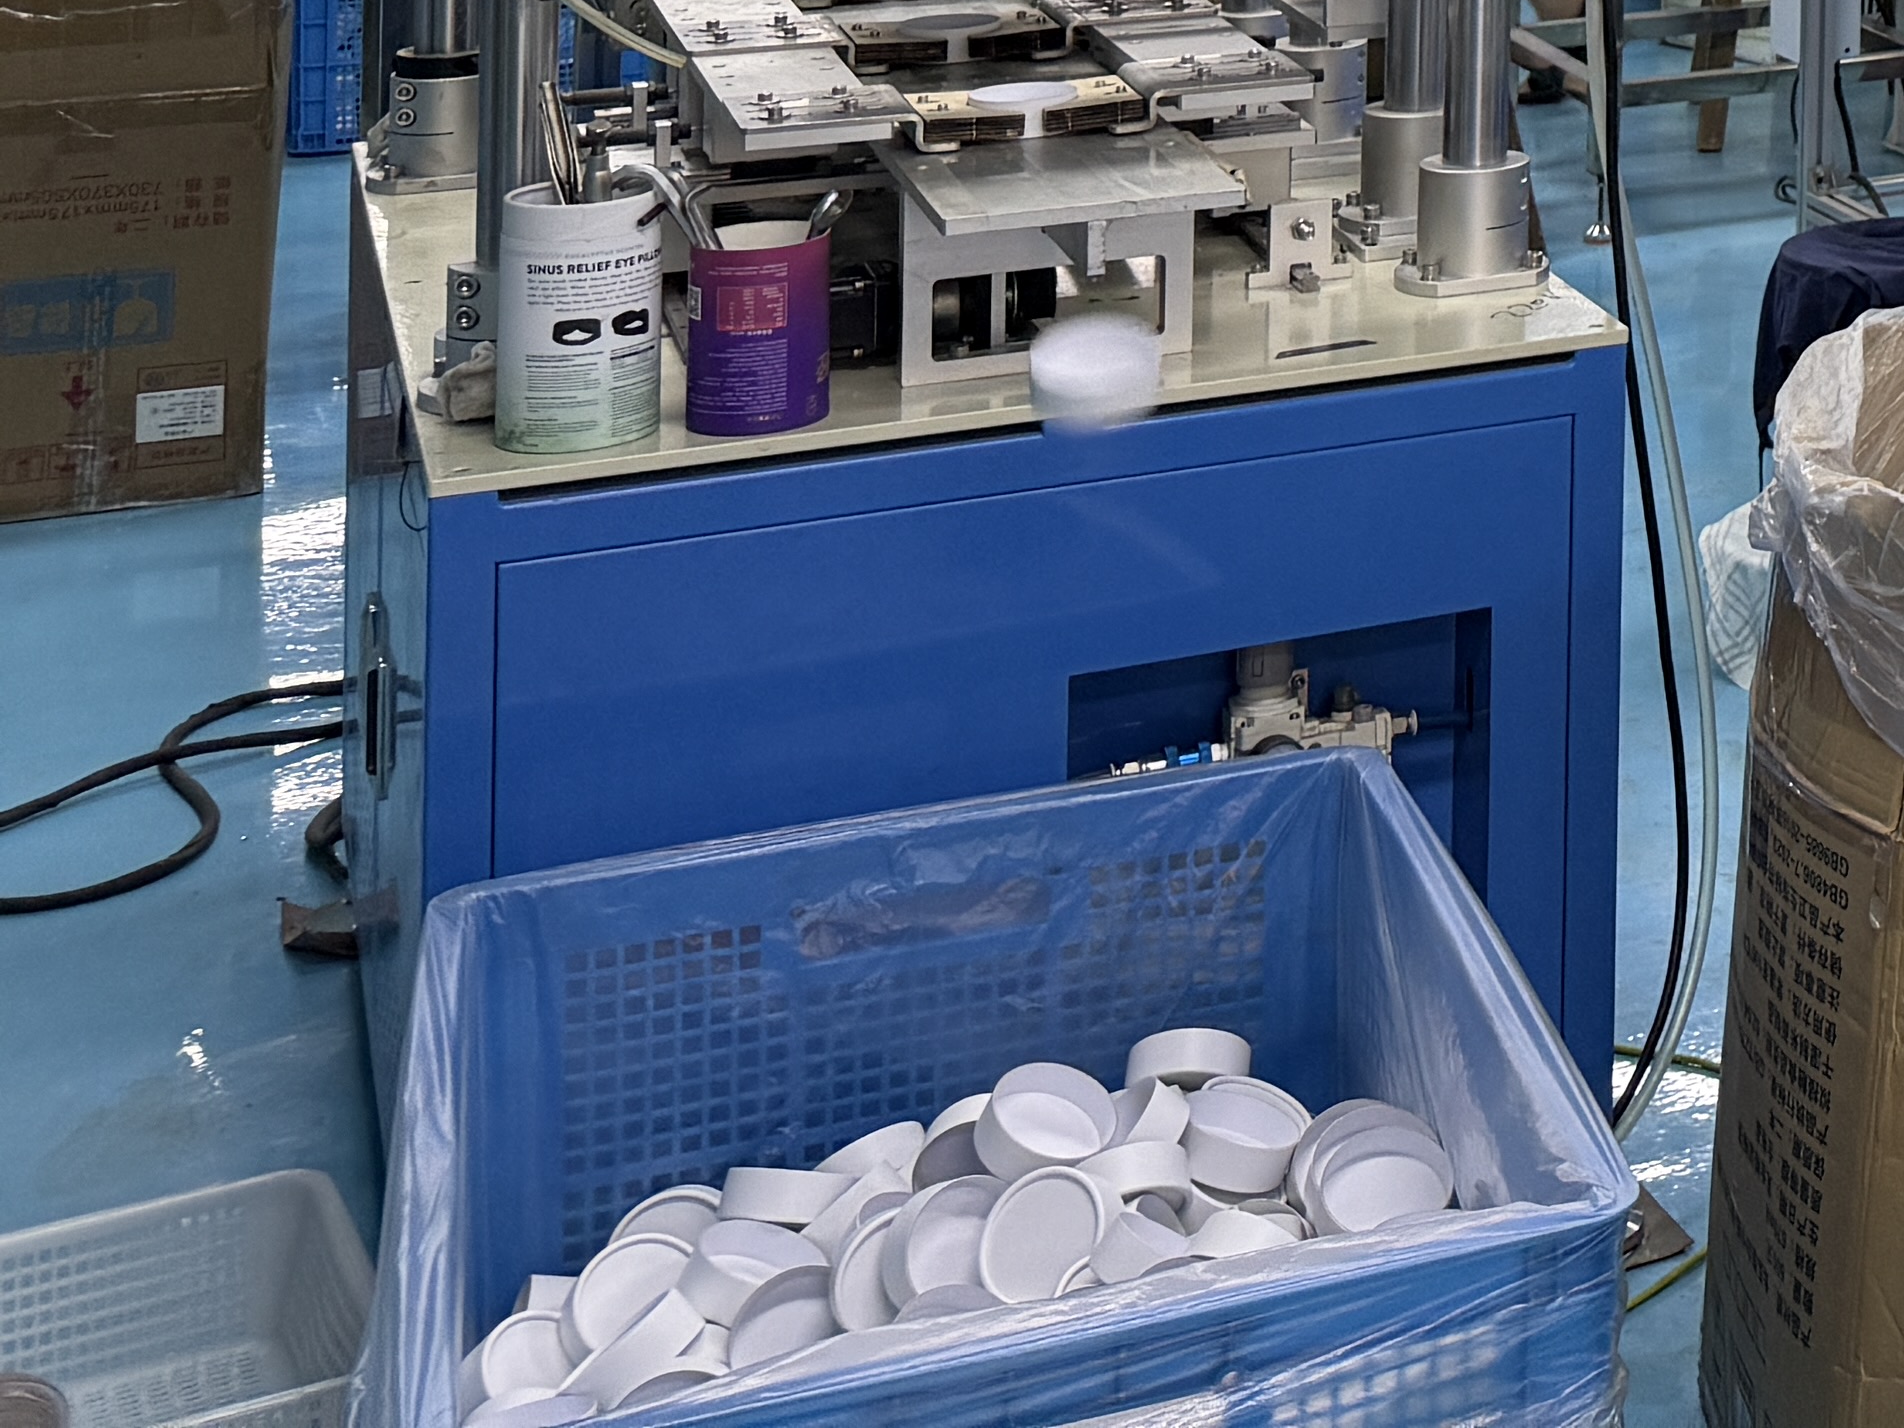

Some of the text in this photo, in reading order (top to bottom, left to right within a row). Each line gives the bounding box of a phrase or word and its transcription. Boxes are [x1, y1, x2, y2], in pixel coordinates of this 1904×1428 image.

[526, 263, 564, 275] SINUS
[566, 261, 612, 275] RELIEF
[614, 255, 636, 269] EYE
